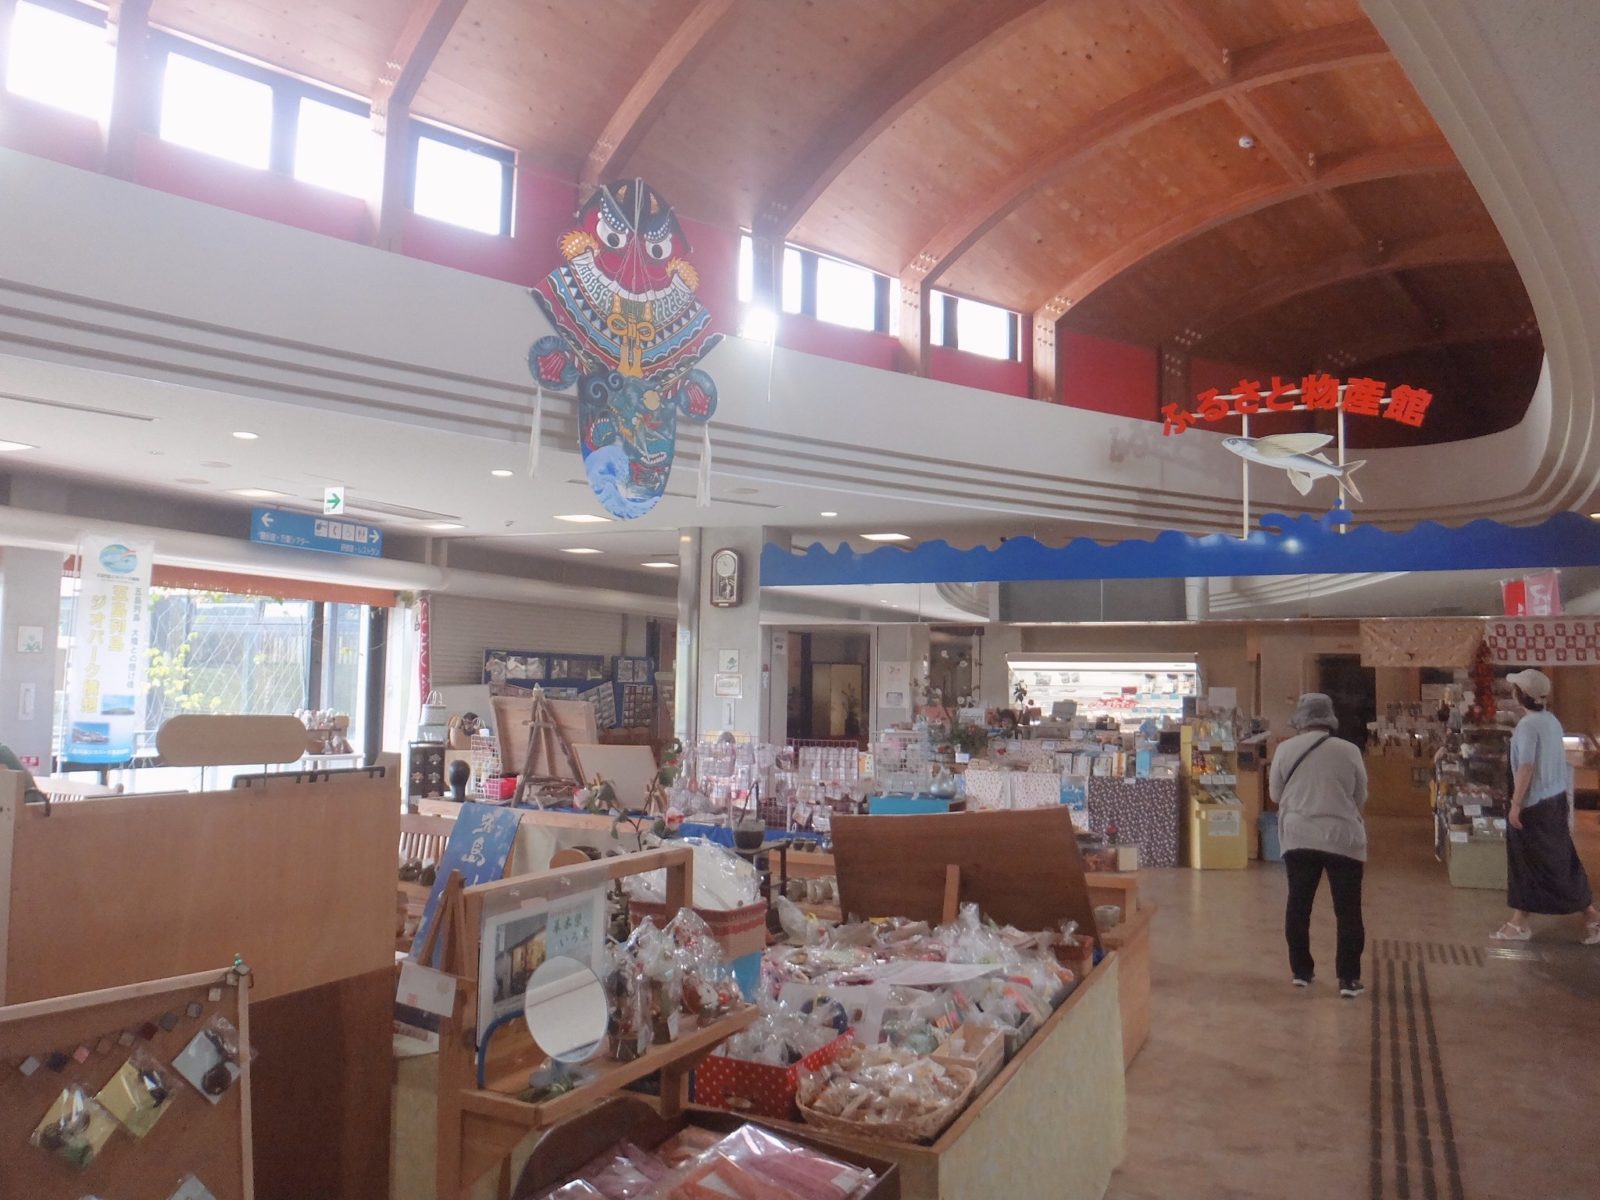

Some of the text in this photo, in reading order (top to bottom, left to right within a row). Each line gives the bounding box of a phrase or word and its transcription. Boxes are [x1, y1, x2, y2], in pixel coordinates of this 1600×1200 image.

[1160, 373, 1433, 437] ふるさと物産館
